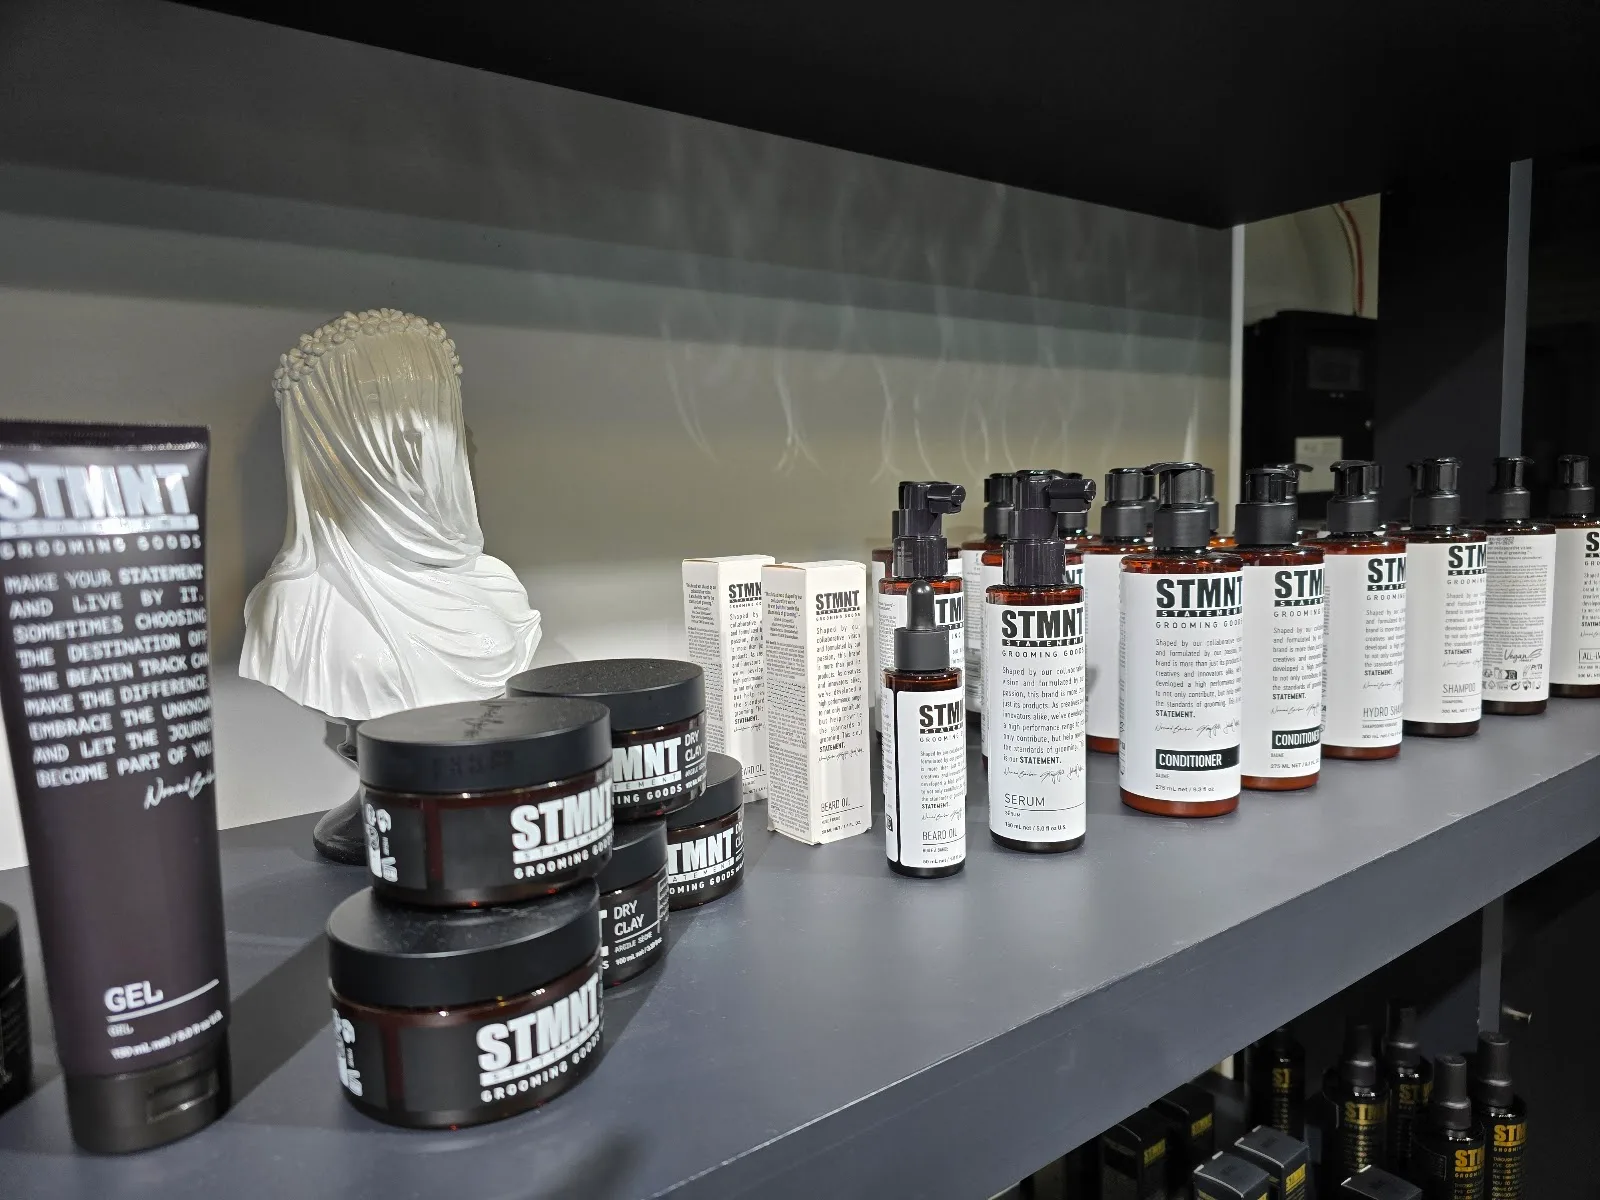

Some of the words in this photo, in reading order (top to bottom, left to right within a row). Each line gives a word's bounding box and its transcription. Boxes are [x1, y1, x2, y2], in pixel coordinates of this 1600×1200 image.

[0, 461, 190, 520] STMNT
[0, 536, 126, 560] GROOMING
[137, 534, 201, 551] GOODS
[1448, 544, 1486, 569] STM
[4, 572, 59, 595] MAKE
[64, 568, 113, 589] YOUR
[118, 563, 203, 585] STATEMENT
[1275, 568, 1325, 598] STM
[1368, 557, 1406, 583] STM
[729, 582, 761, 598] STMN
[816, 590, 859, 610] STMNT
[1156, 576, 1242, 608] STMNT
[9, 597, 54, 619] AND
[72, 591, 124, 613] LIVE
[140, 588, 163, 607] BY
[1162, 607, 1242, 617] STATEMEN
[13, 615, 124, 644] SOMETIMES
[135, 608, 207, 631] CHOOSING
[1002, 607, 1083, 638] STMNT
[16, 647, 56, 668] THE
[67, 632, 181, 663] DESTINATION
[1002, 650, 1057, 658] GROOMING
[20, 671, 59, 693] THE
[66, 662, 134, 688] BEATEN
[138, 654, 188, 677] TRACK
[1002, 667, 1024, 676] Shaped
[1029, 668, 1036, 676] by
[1003, 690, 1025, 698] passion,
[1028, 690, 1039, 698] this
[1442, 683, 1475, 693] SHAMPOO
[24, 693, 75, 716] MAKE
[78, 687, 116, 710] THE
[919, 699, 963, 727] STM
[1156, 710, 1195, 718] STATEMENT.
[1363, 706, 1388, 717] HYDRO
[28, 713, 113, 741] EMBRACE
[120, 706, 155, 727] THE
[1022, 722, 1059, 732] performance
[1033, 712, 1049, 721] alike,
[33, 743, 69, 765] AND
[79, 736, 116, 759] LET
[125, 728, 159, 750] THE
[685, 733, 699, 746] DRY
[36, 761, 109, 789] BECOME
[117, 751, 160, 776] PART
[167, 745, 187, 765] OF
[612, 737, 681, 782] MNT
[1020, 756, 1061, 764] STATEMENT.
[1159, 753, 1222, 767] CONDITIONER
[613, 775, 678, 791] TEMENT
[647, 784, 682, 800] GOODS
[1005, 793, 1045, 806] SERUM
[511, 778, 612, 850] STMNT
[922, 830, 946, 840] BEARD
[949, 828, 957, 838] OIL
[514, 849, 589, 879] GROOMING
[667, 827, 733, 875] TMNT
[669, 882, 704, 895] OMING
[710, 869, 734, 885] GOODS
[673, 860, 731, 882] ATEMENT
[613, 900, 637, 920] DRY
[614, 914, 644, 936] CLAY
[104, 980, 163, 1012] GEL
[476, 972, 598, 1071] STMNT
[481, 1061, 568, 1102] GROOMING
